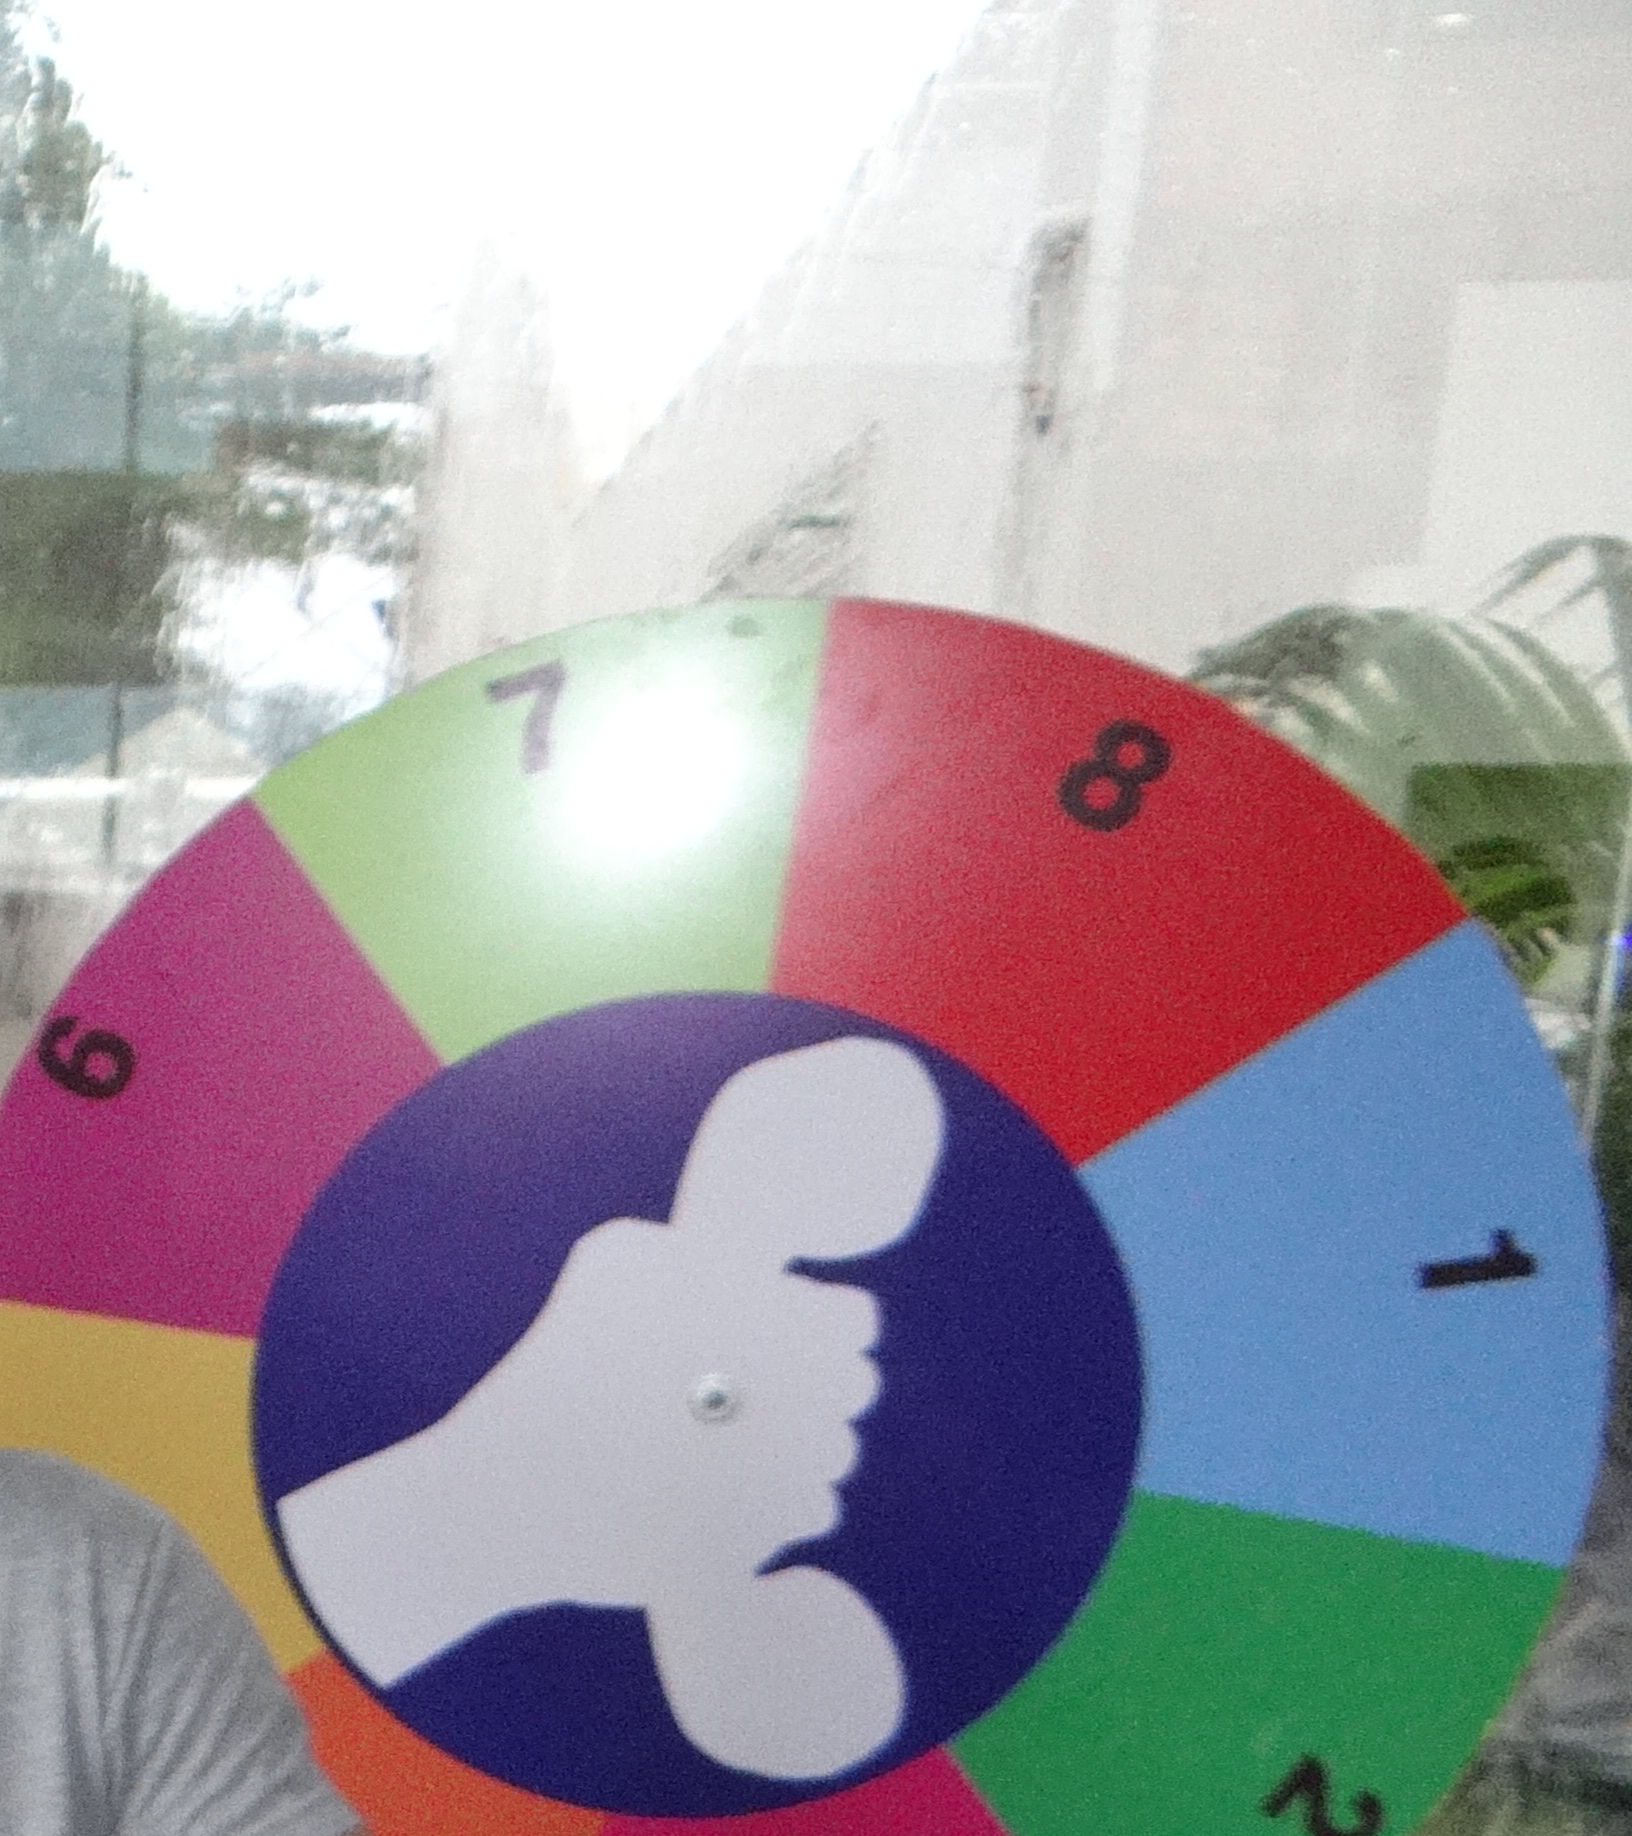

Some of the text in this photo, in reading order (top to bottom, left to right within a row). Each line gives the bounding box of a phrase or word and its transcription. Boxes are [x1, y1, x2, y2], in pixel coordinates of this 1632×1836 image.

[483, 659, 568, 775] 7
[1059, 716, 1172, 834] 8
[36, 1011, 137, 1100] 6
[1416, 1229, 1539, 1291] 1
